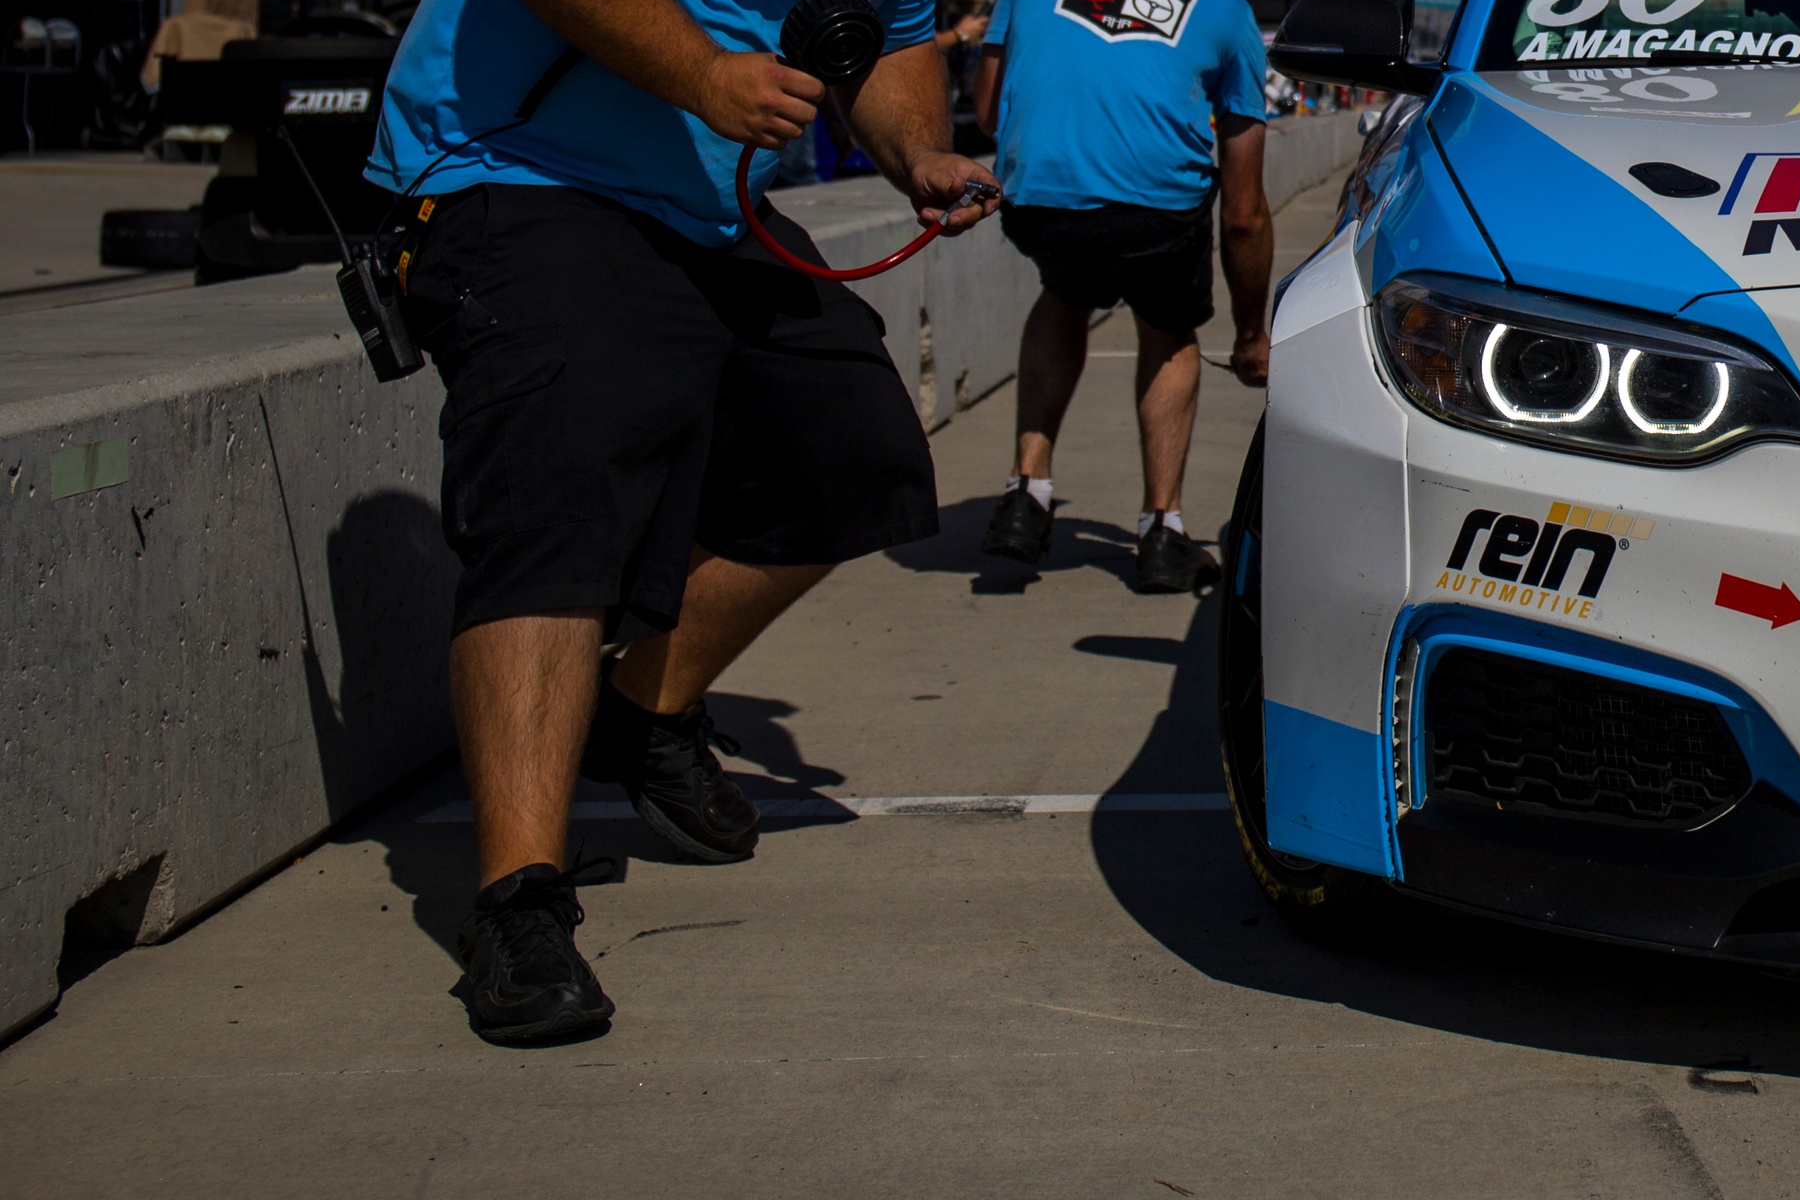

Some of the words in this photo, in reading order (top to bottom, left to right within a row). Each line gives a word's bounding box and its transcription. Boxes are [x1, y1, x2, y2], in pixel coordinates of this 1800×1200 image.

[283, 87, 371, 115] ZIMA
[1446, 502, 1617, 599] rein
[1436, 571, 1594, 620] AUTOMOTIVE
